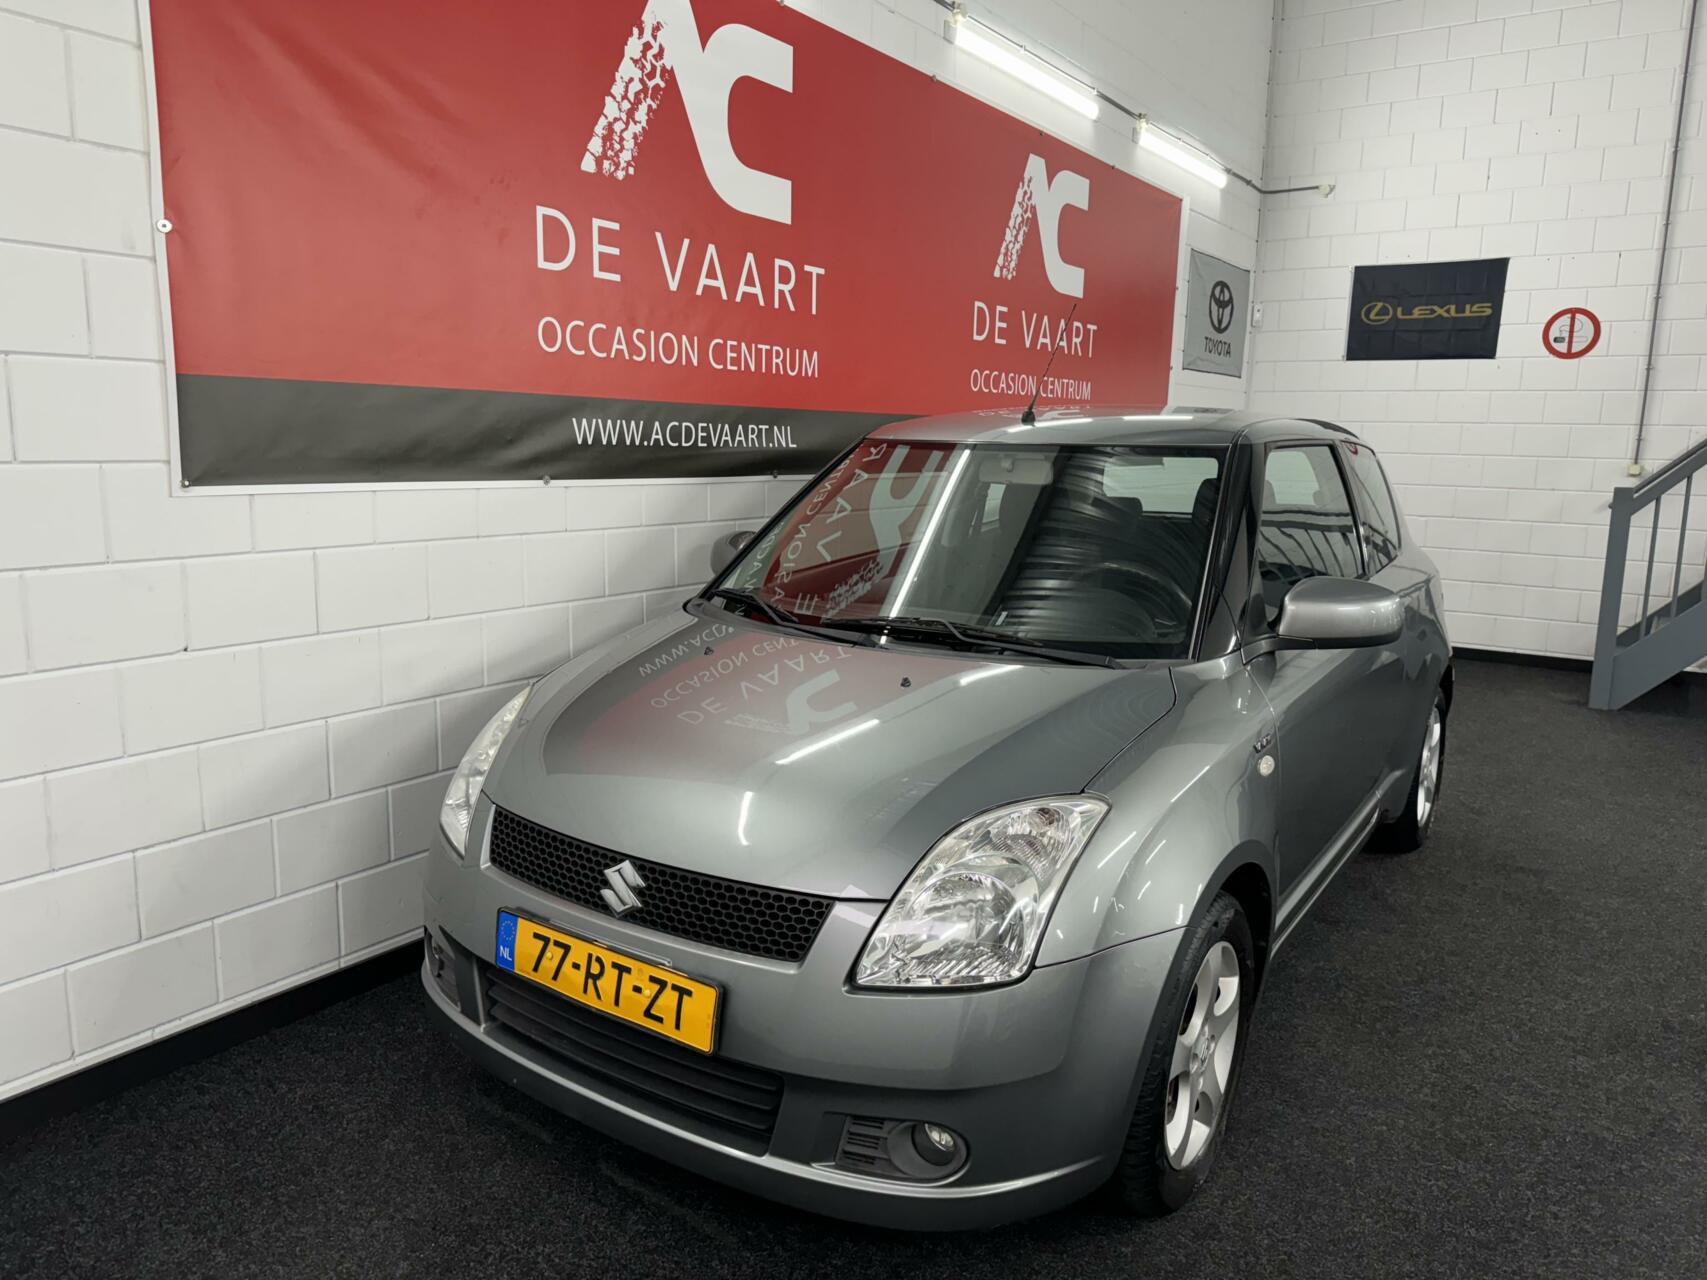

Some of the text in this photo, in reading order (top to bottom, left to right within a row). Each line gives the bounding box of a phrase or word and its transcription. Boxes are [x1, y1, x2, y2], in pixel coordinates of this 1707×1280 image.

[536, 205, 825, 315] DE VAART
[1397, 303, 1493, 319] LEXUS
[973, 301, 1098, 358] DE VAART
[537, 316, 819, 378] OCCASION CENTRUM
[1204, 336, 1231, 359] TOYOTA
[970, 369, 1092, 400] OCCASION CENTRUM
[572, 417, 797, 449] WWW.ACDEVAART.NL
[499, 945, 513, 962] NL
[531, 931, 694, 1032] 77-RT-ZT
